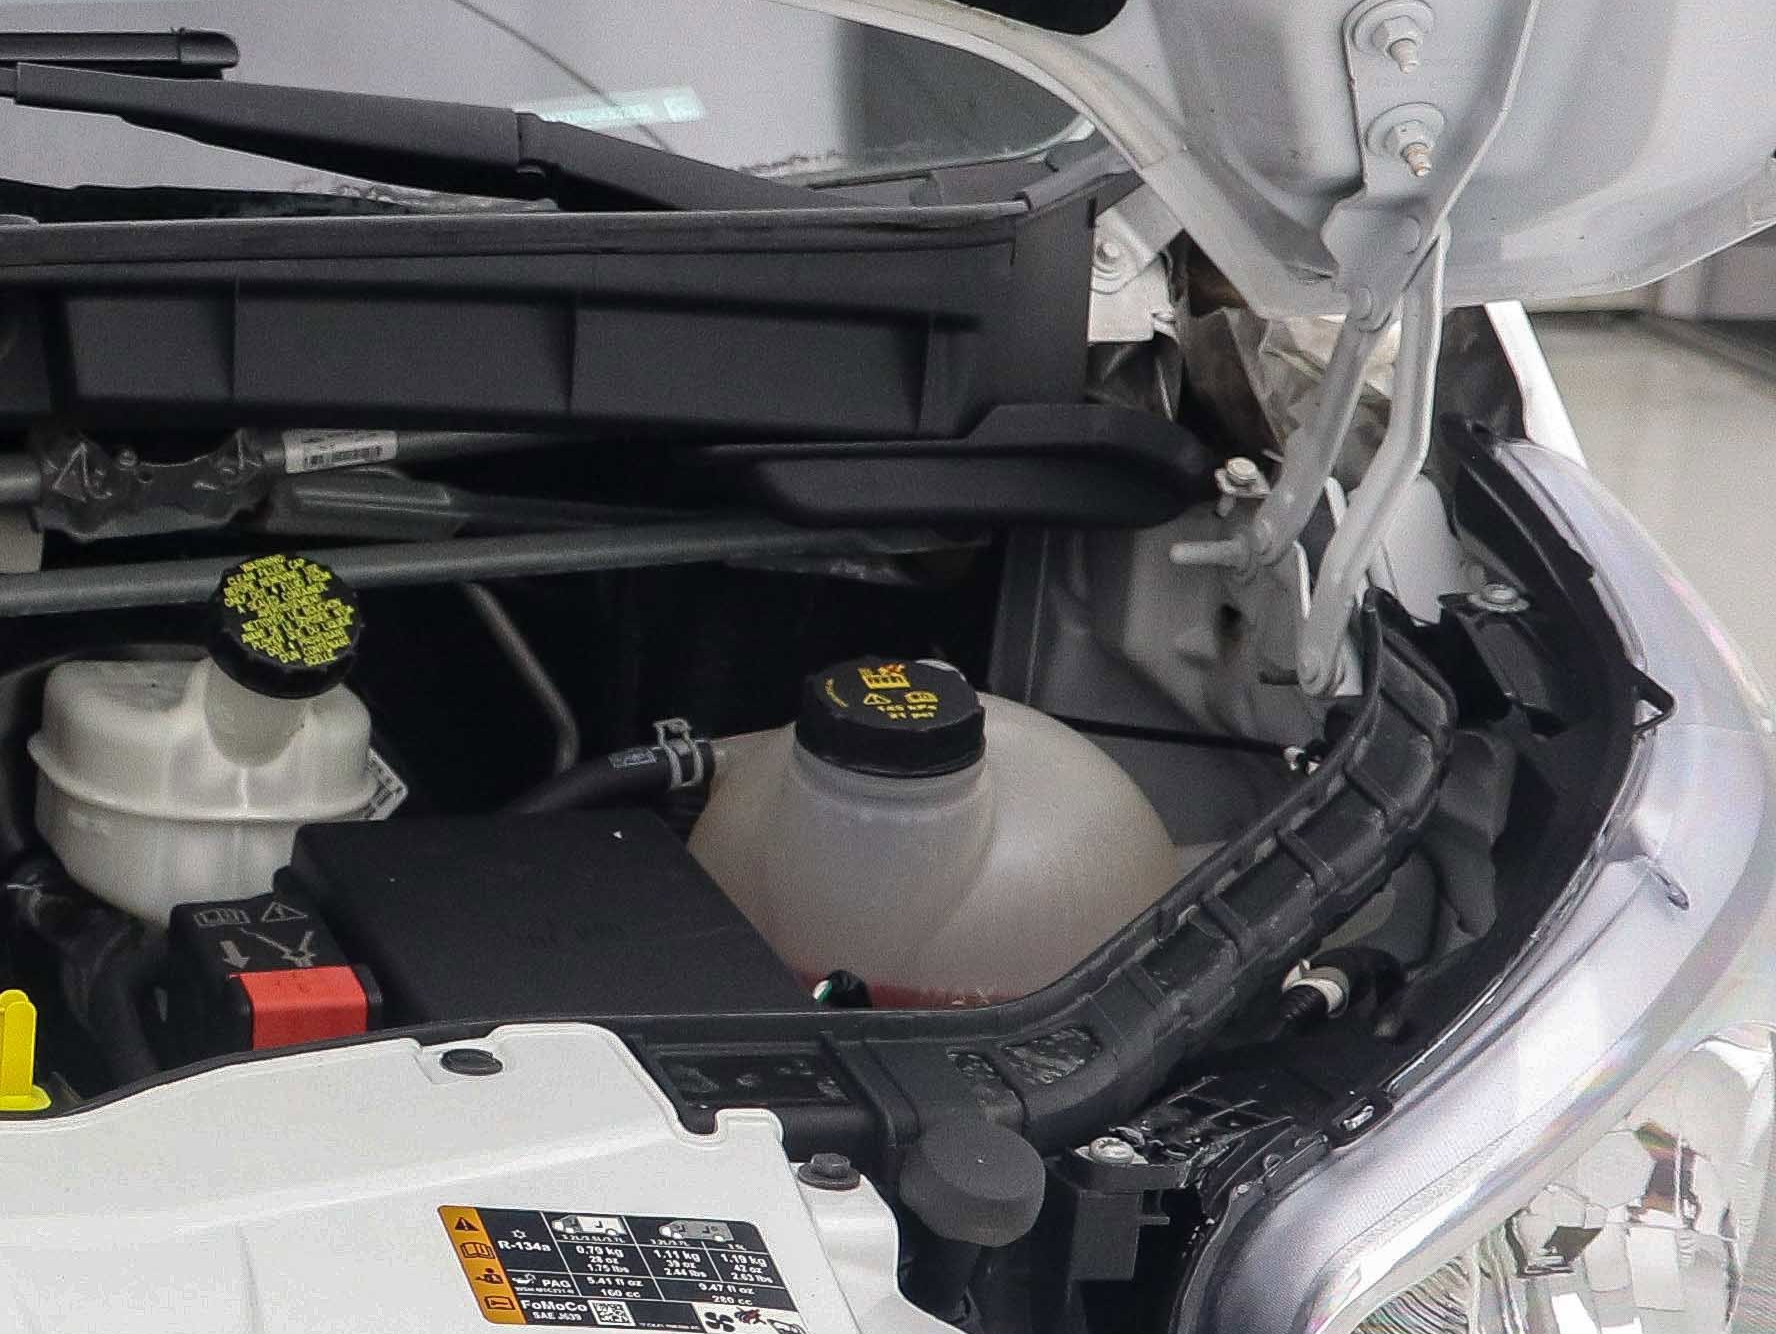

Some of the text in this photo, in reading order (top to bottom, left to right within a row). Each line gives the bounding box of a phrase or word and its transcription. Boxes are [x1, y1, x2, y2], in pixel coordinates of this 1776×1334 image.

[497, 1240, 551, 1252] R-134a
[576, 1245, 624, 1258] 0.79 kg
[653, 1249, 700, 1262] 1.11 kg
[605, 1257, 619, 1265] oz
[682, 1261, 697, 1269] oz
[720, 1253, 767, 1268] 1.19 kg
[612, 1265, 630, 1274] lbs
[689, 1269, 707, 1278] lbs
[733, 1265, 747, 1273] 42
[542, 1279, 572, 1288] PAG
[586, 1277, 644, 1287] 5.41 fl oz
[755, 1274, 773, 1284] lbs
[600, 1288, 623, 1297] 160
[726, 1284, 737, 1293] fl
[739, 1287, 755, 1295] oz
[521, 1299, 588, 1312] FoMoCo
[737, 1298, 753, 1306] cc
[533, 1312, 555, 1320] SAE
